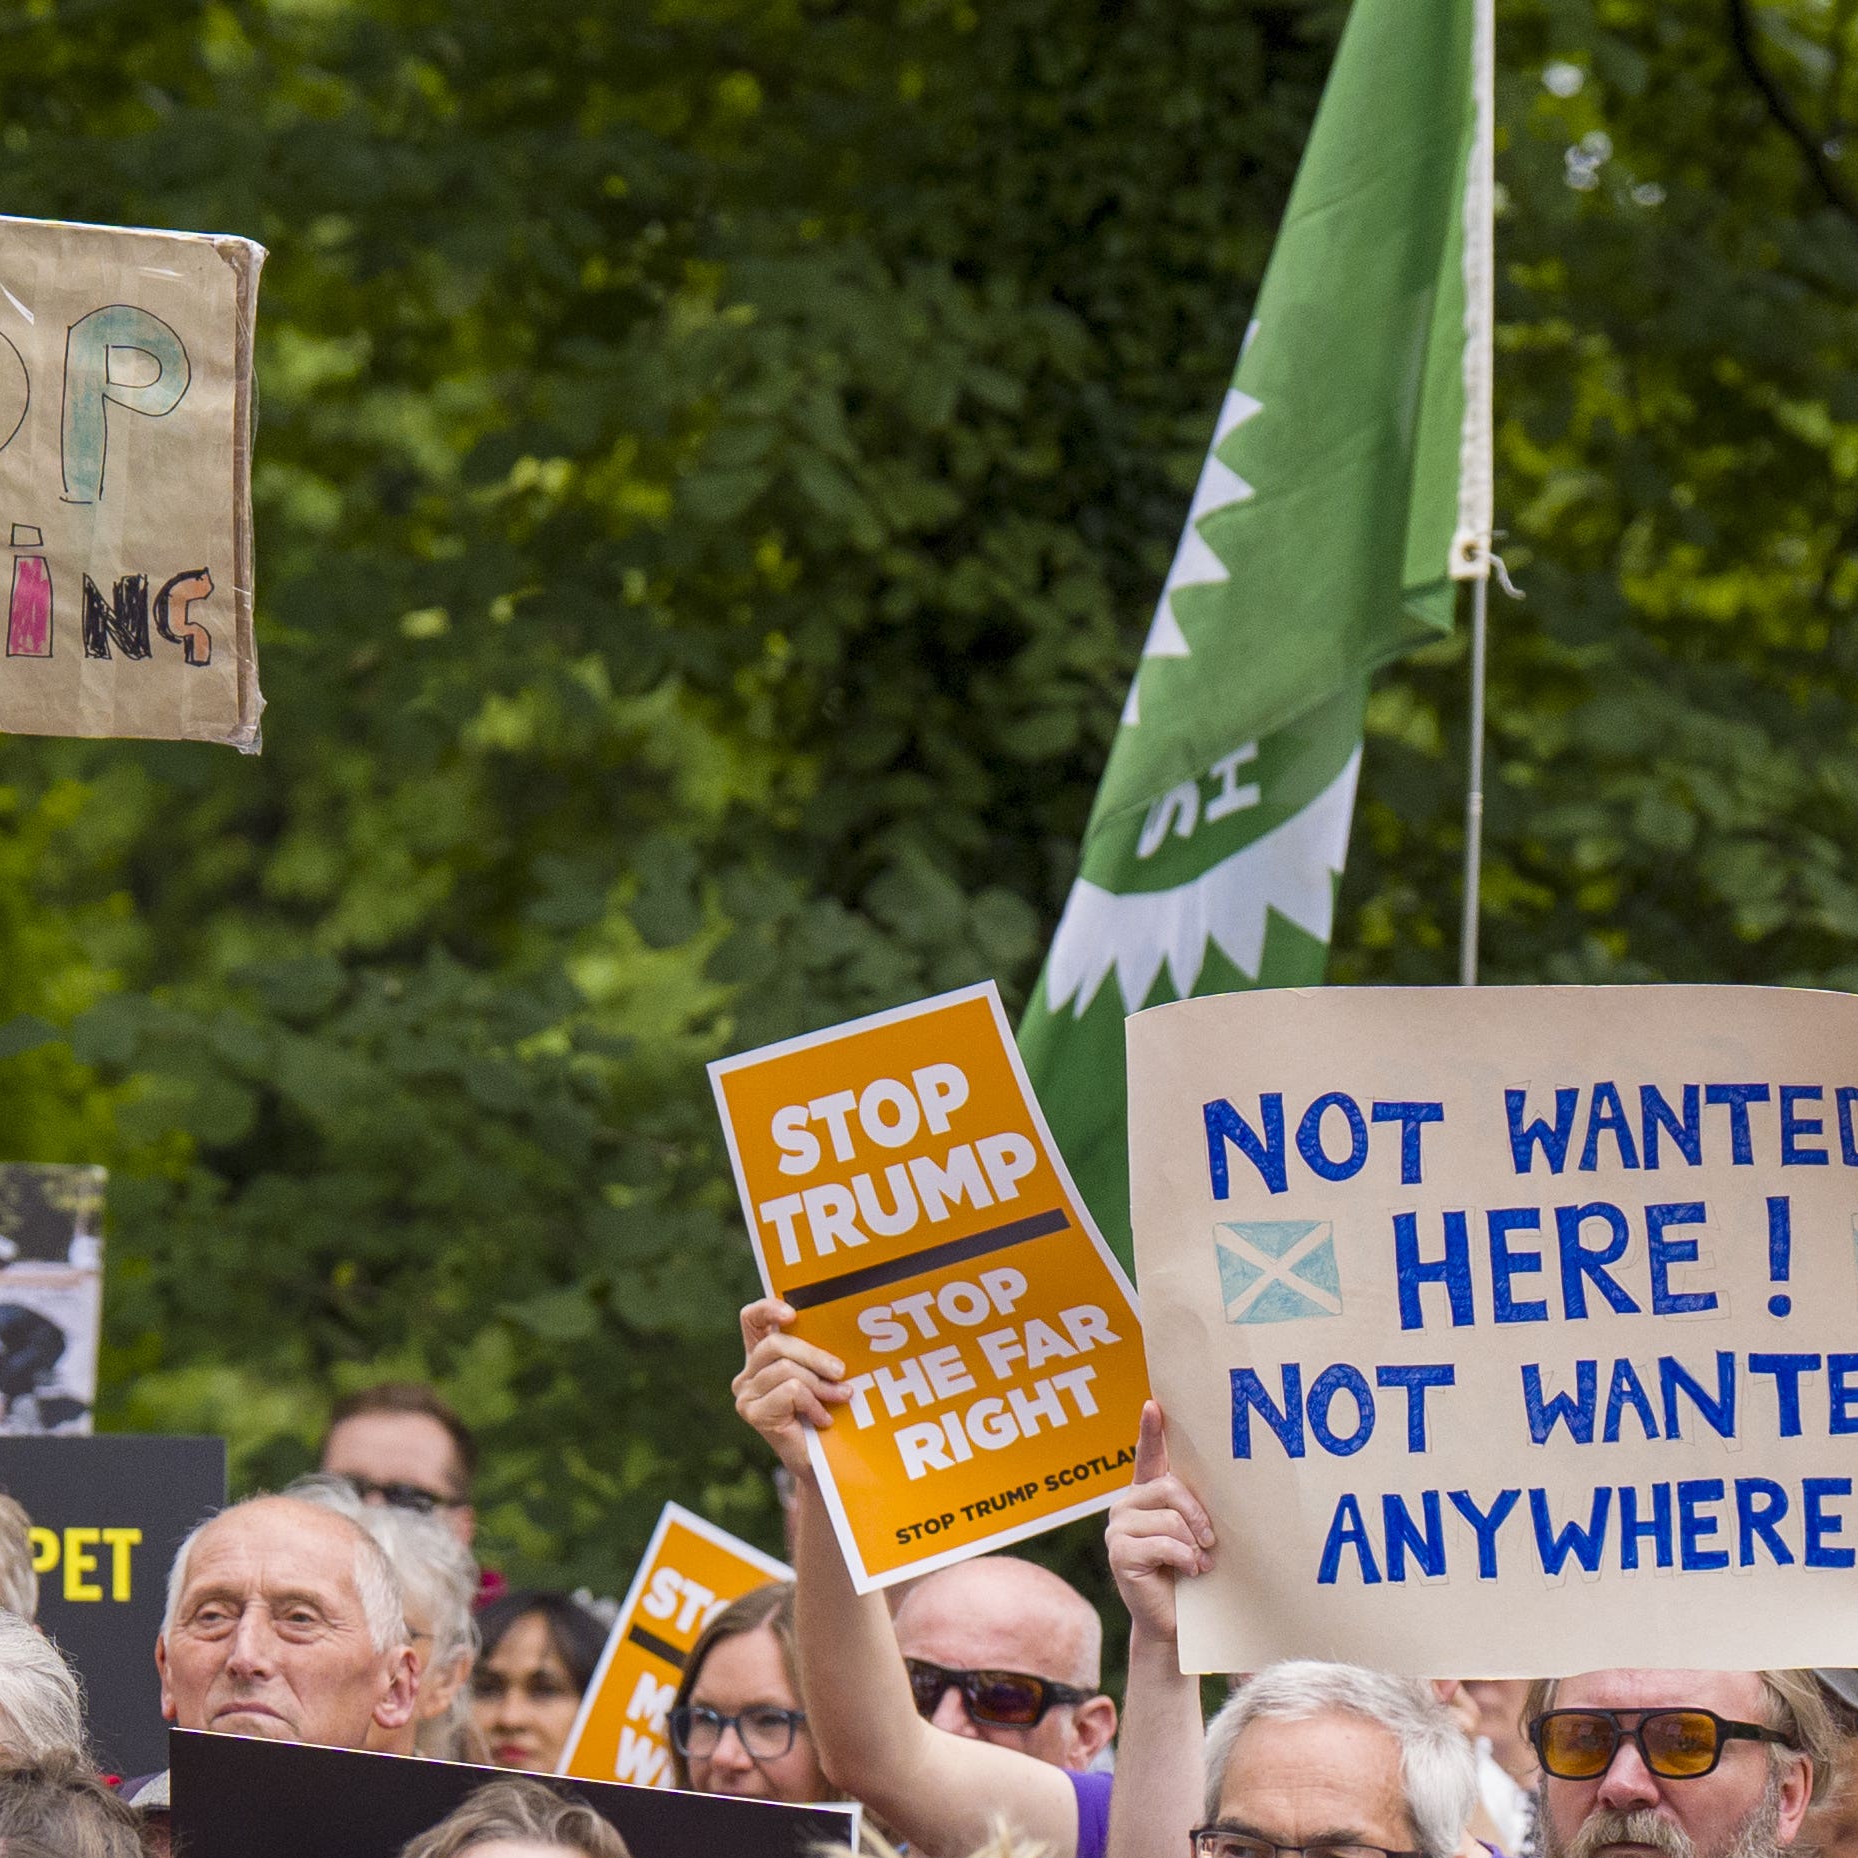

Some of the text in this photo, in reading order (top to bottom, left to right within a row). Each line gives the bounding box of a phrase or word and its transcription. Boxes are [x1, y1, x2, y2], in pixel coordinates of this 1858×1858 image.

[771, 1062, 970, 1177] STOP
[1203, 1091, 1444, 1200] NOT
[759, 1132, 1038, 1266] TRUMP
[857, 1267, 1028, 1352] STOP
[847, 1304, 1122, 1430] THE FAR
[1229, 1362, 1455, 1460] NOT
[894, 1365, 1100, 1481] RIGHT
[28, 1526, 142, 1602] PET
[895, 1513, 955, 1545] STOP
[960, 1482, 1039, 1522] TRUMP
[1317, 1476, 1856, 1585] ANYWHERE
